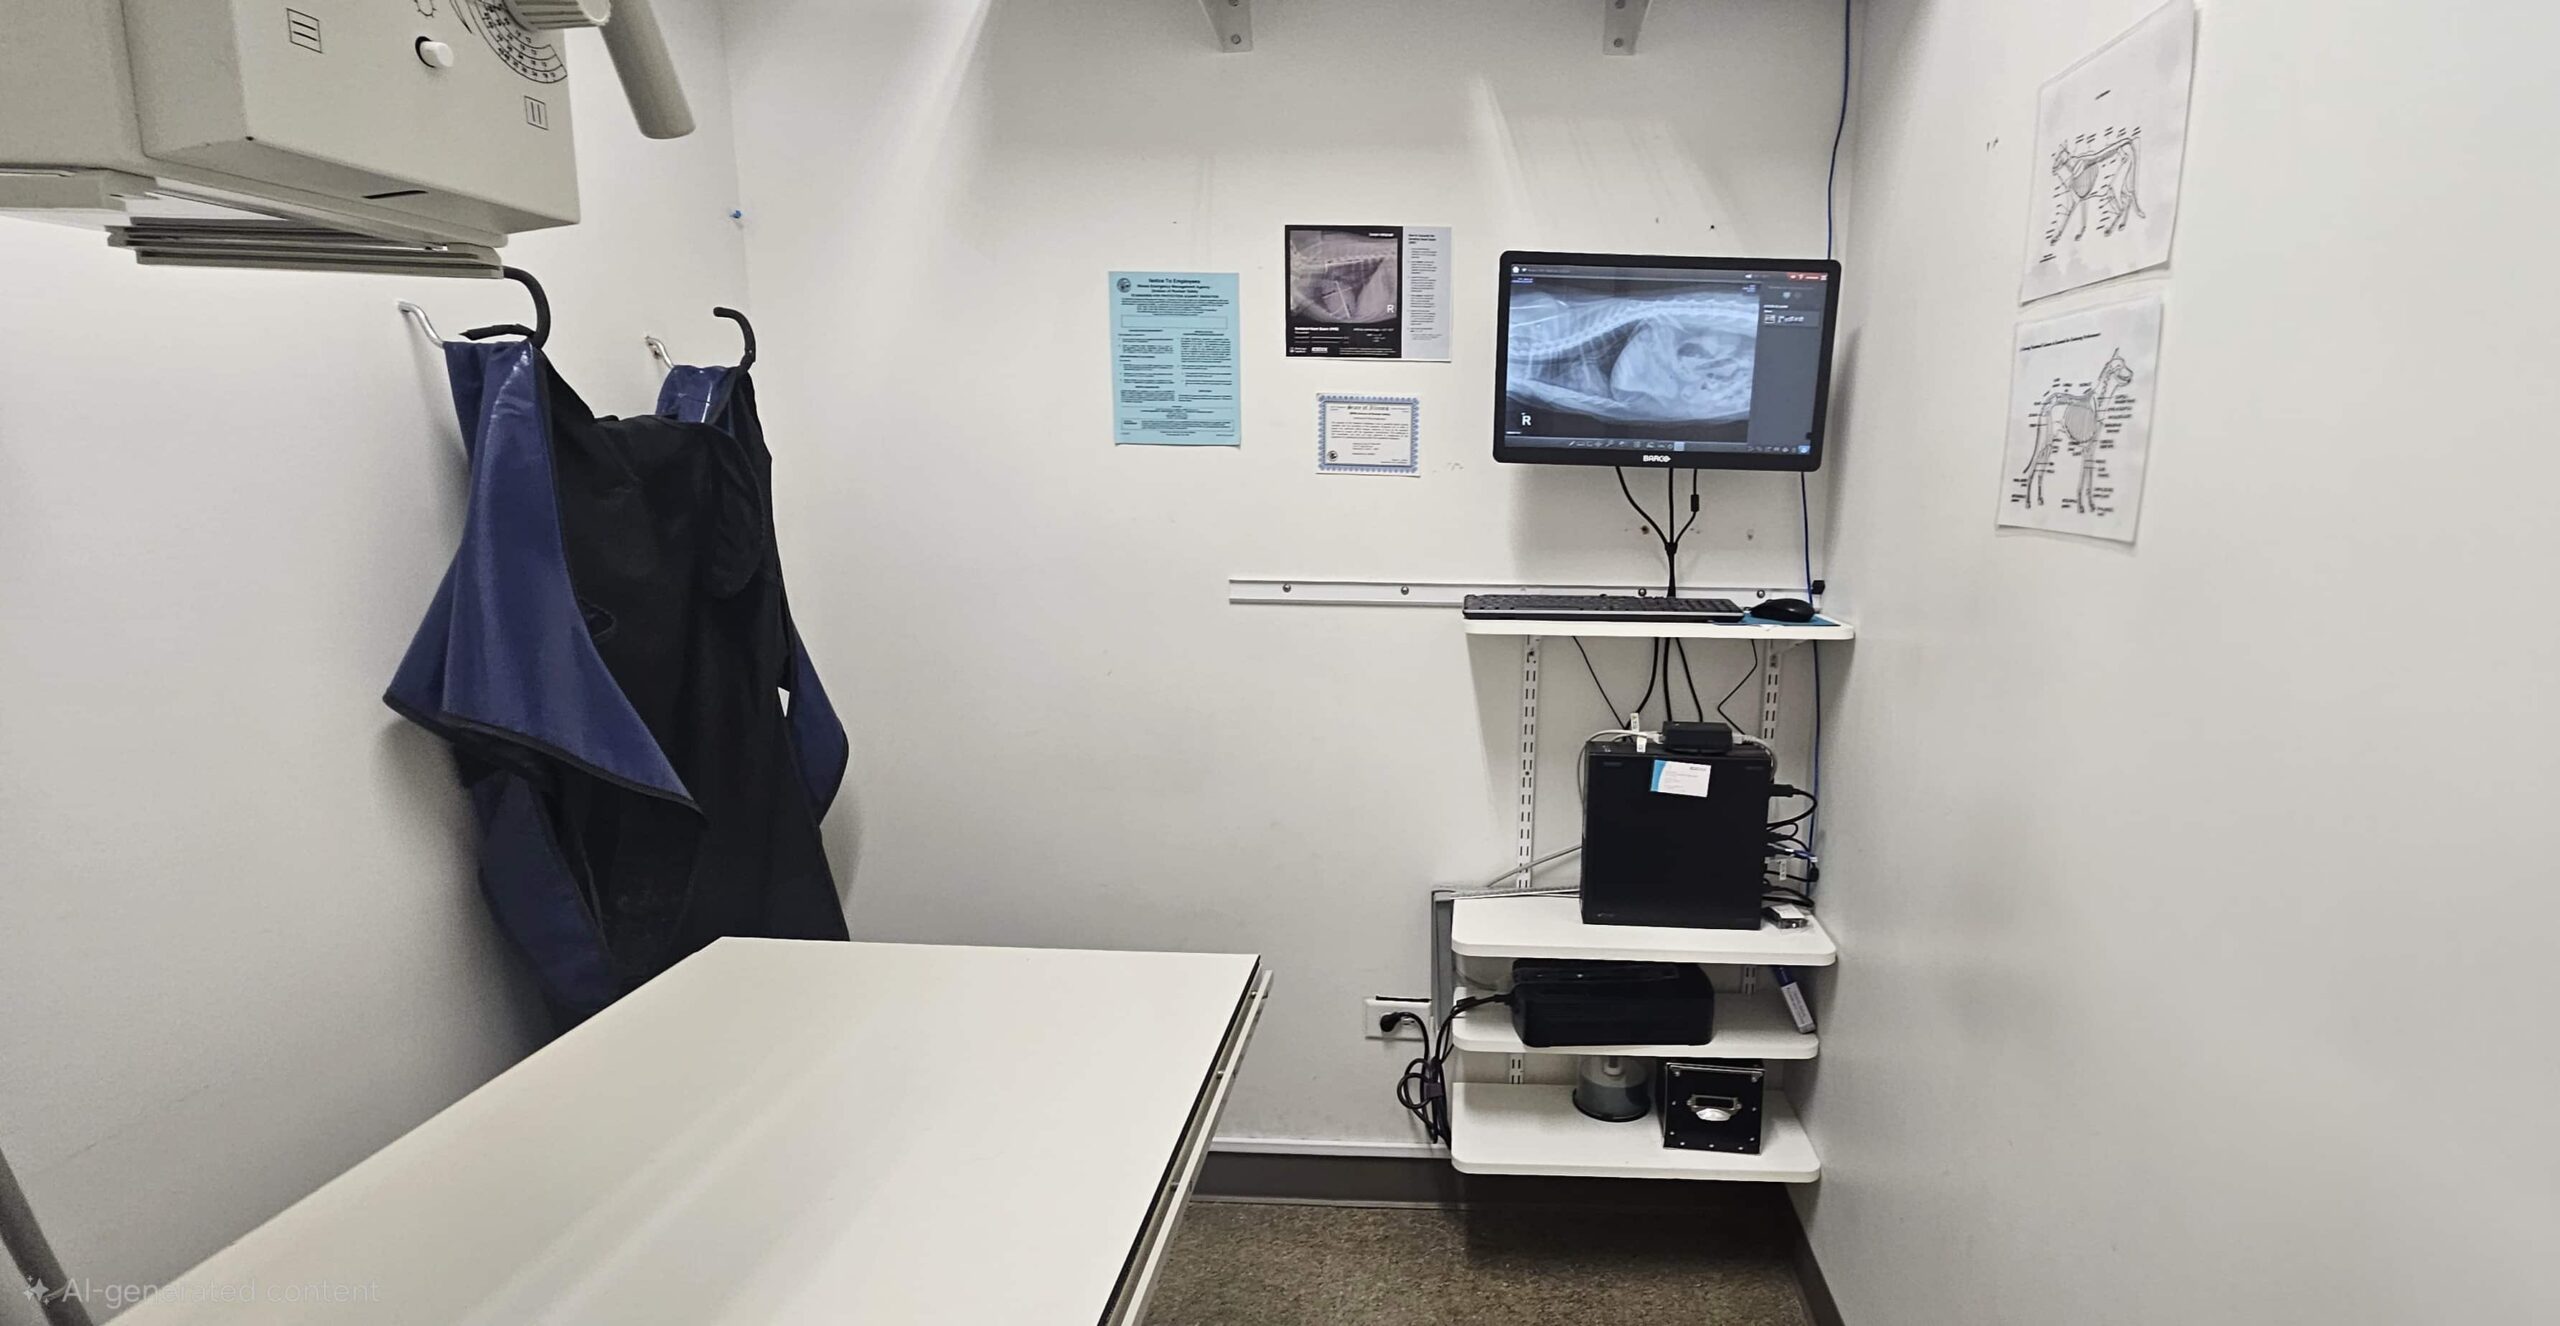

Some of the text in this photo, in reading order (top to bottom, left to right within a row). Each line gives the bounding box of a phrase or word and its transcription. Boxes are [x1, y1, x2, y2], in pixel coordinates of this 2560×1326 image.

[1387, 304, 1394, 313] R
[1522, 415, 1531, 426] R
[1643, 455, 1671, 463] BARCO
